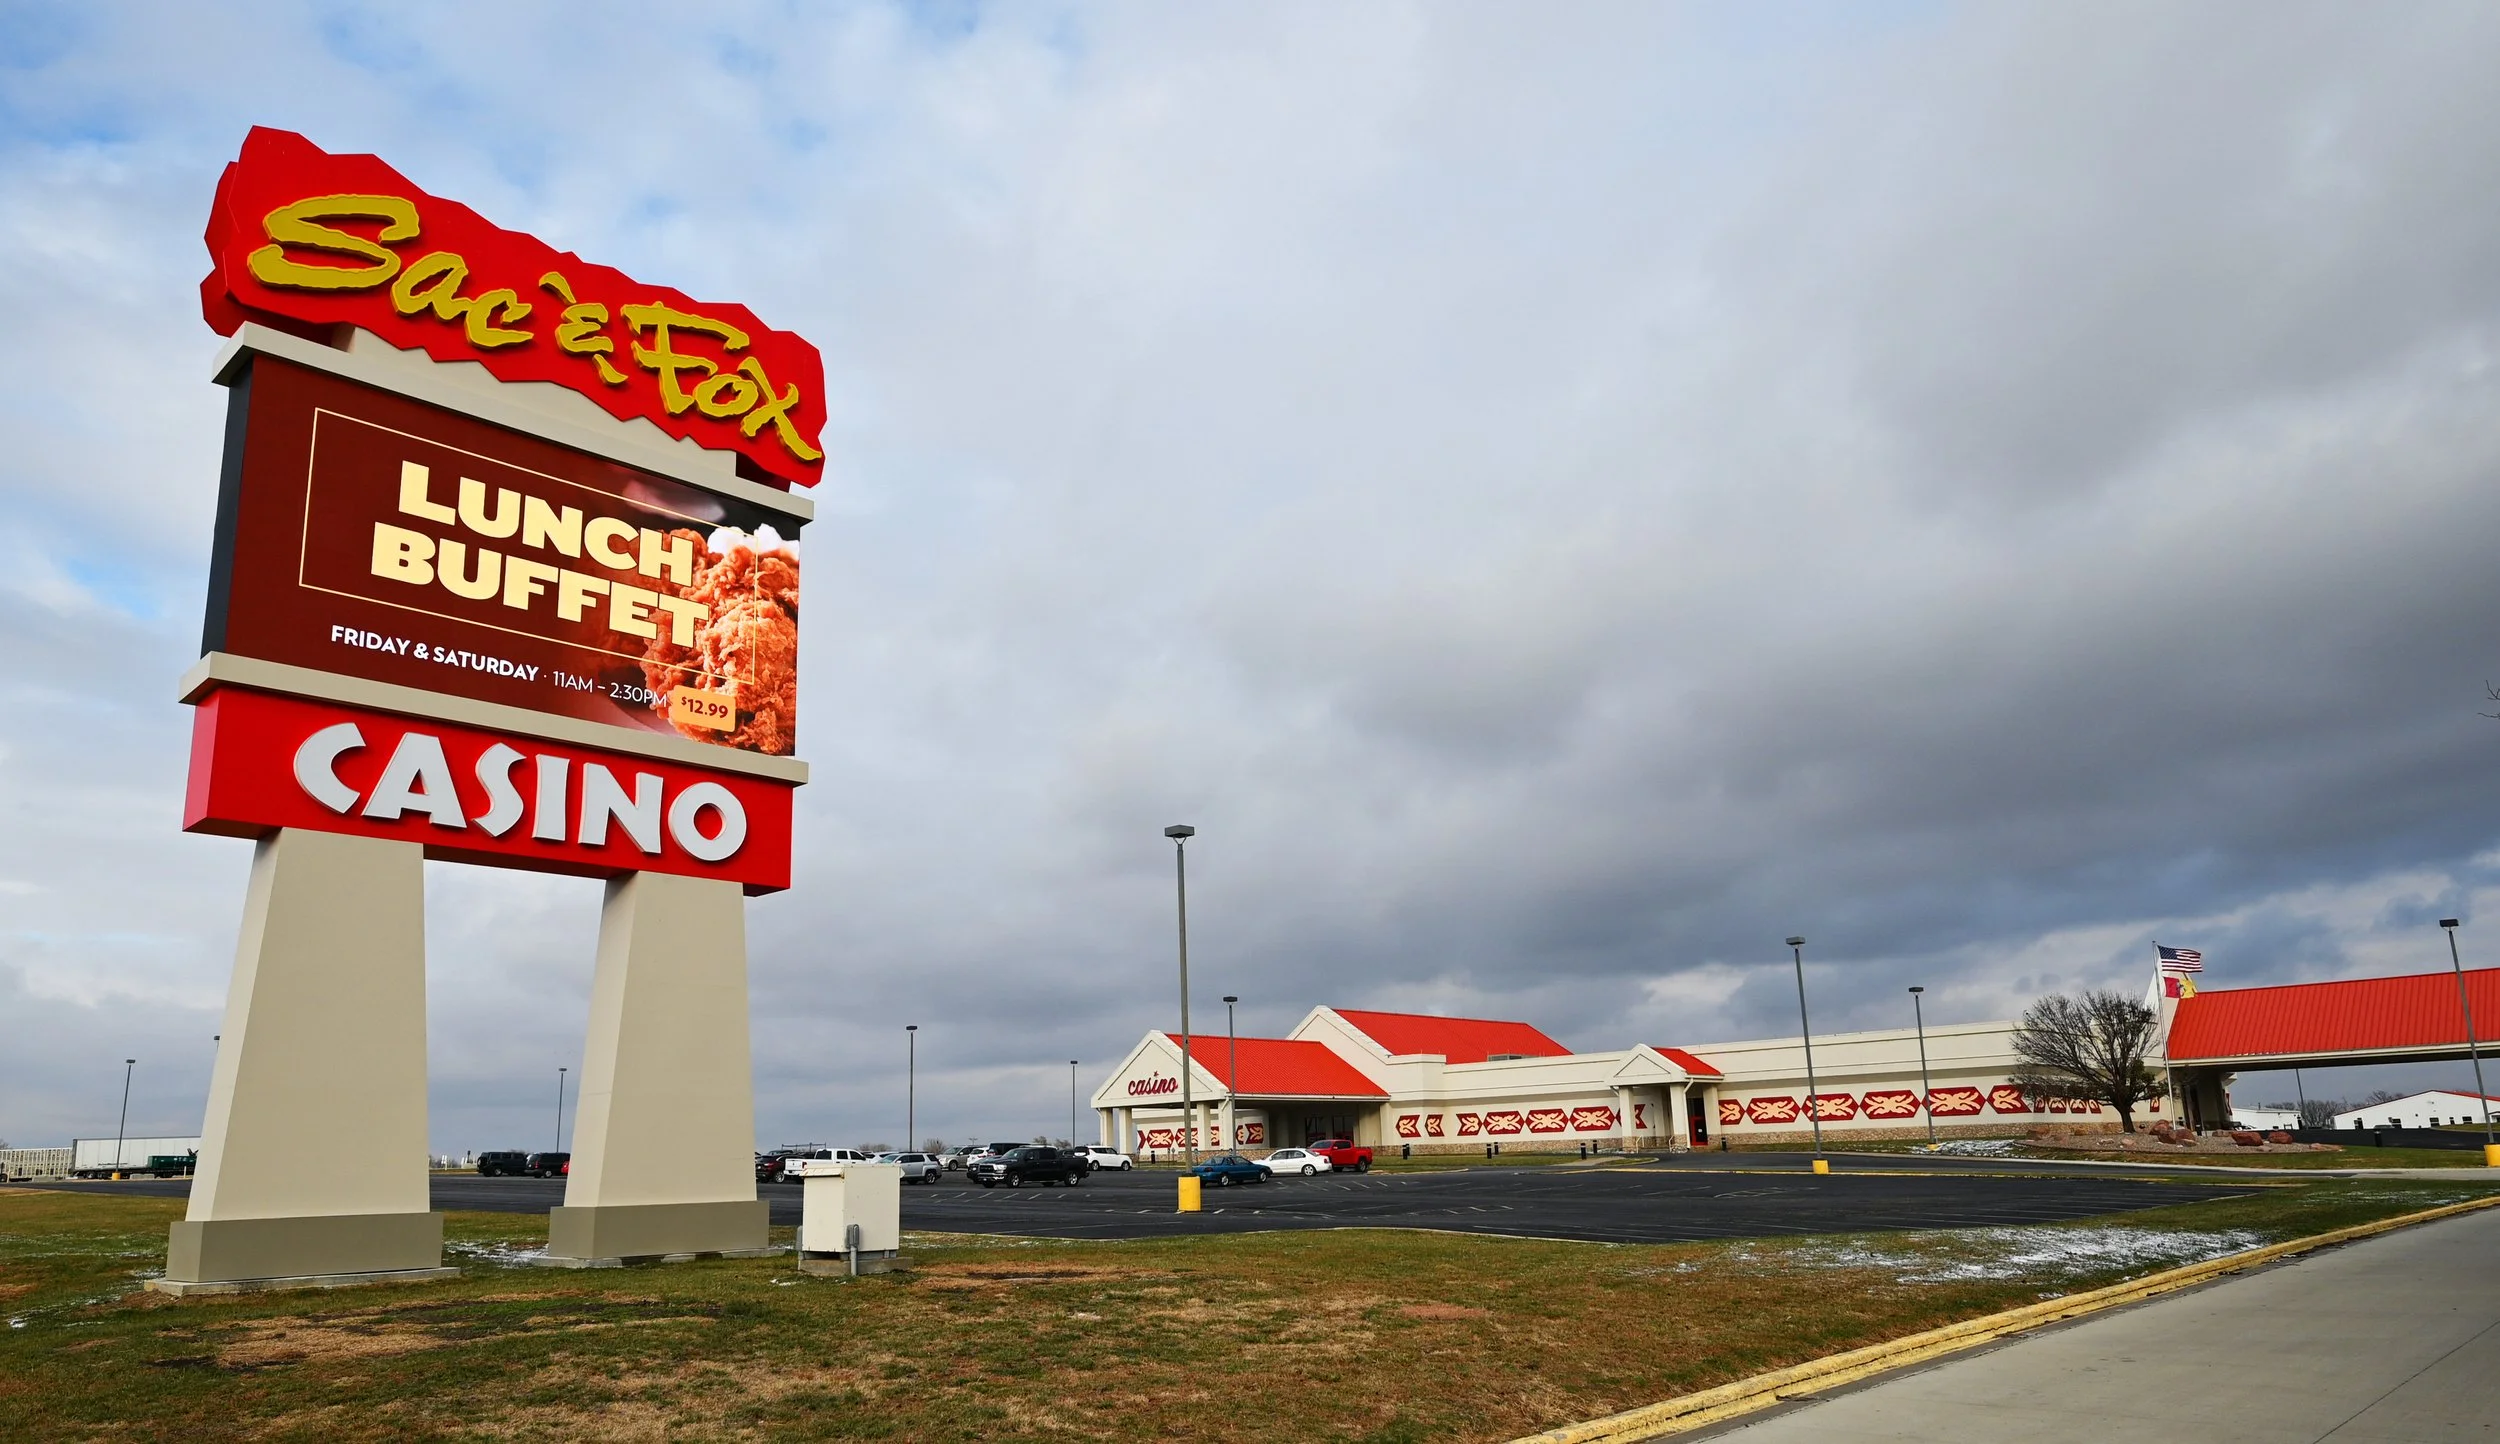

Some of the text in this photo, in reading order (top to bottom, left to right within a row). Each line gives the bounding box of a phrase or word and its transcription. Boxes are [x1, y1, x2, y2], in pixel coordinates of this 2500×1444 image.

[247, 194, 535, 349] Sac
[621, 301, 823, 462] Fox
[370, 521, 710, 648] BUFFET
[398, 460, 695, 585] LUNCH
[331, 625, 411, 656] FRIDAY
[413, 643, 429, 660] &
[433, 647, 539, 681] SATURDAY
[552, 670, 593, 693] 11AM
[609, 682, 668, 708] 2:30PM
[681, 696, 729, 719] $12.99
[292, 722, 748, 862] CASINO
[1128, 1071, 1178, 1095] casino
